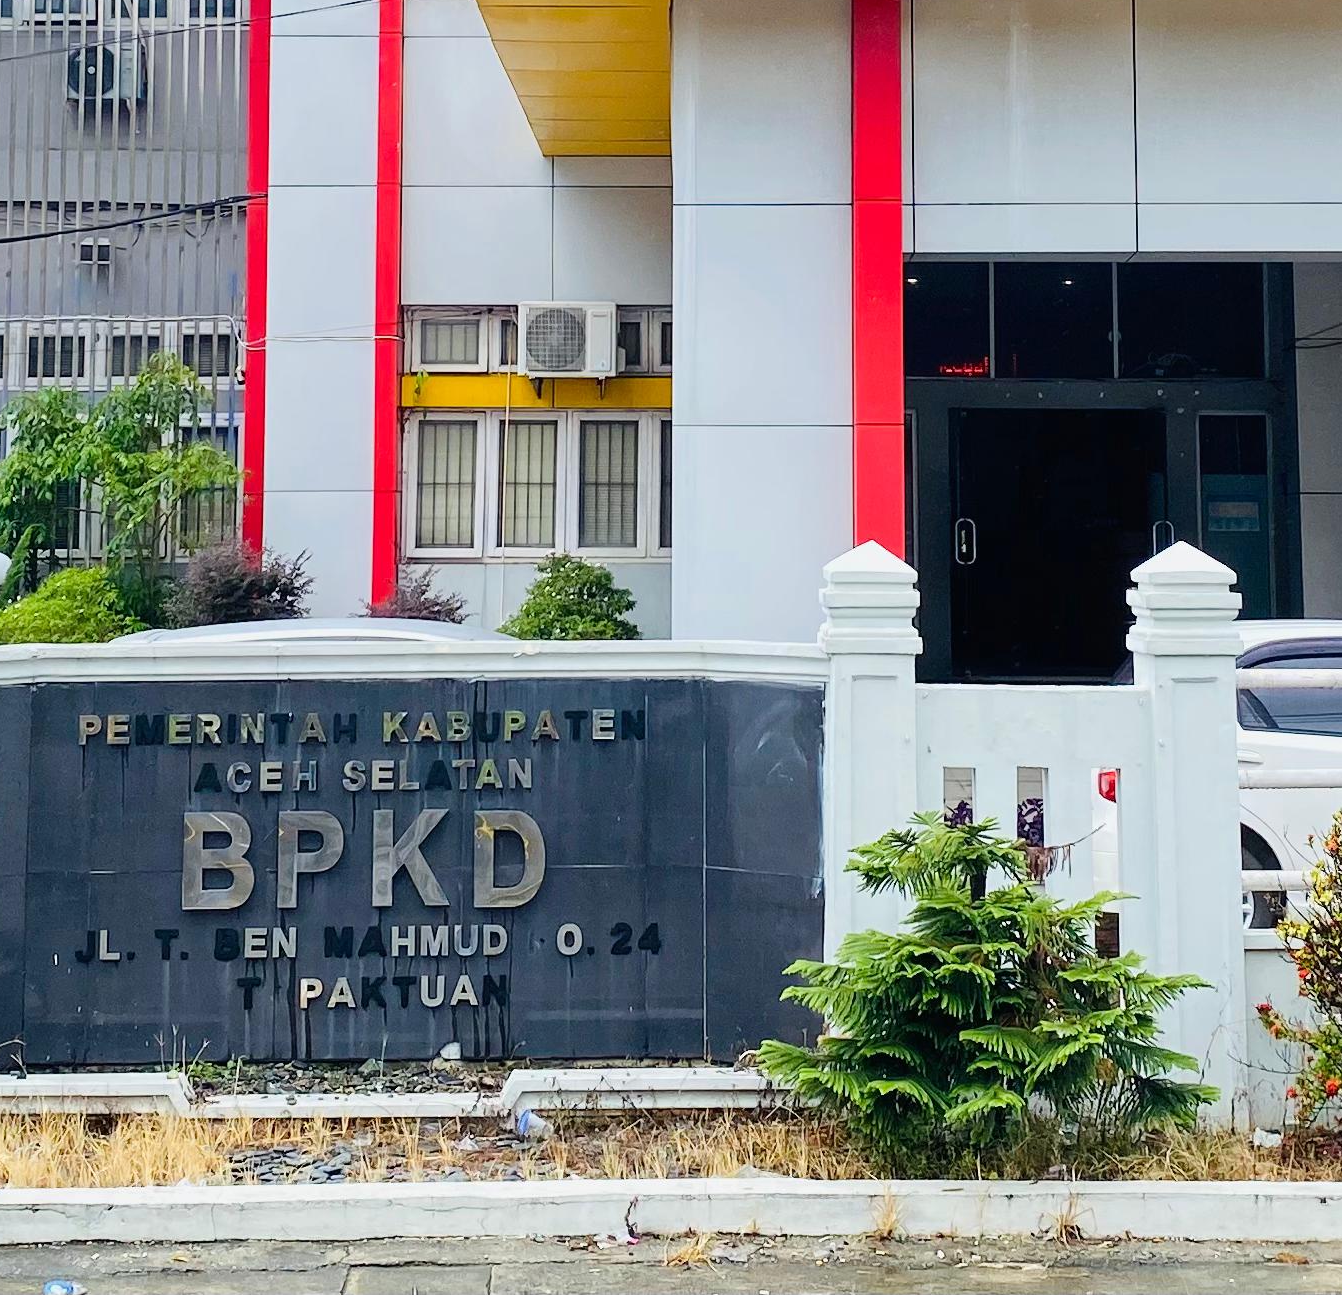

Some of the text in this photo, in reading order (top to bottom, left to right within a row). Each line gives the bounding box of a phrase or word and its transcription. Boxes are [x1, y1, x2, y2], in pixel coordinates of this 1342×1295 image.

[77, 708, 647, 747] PEMERINTAH KABUPATEN
[193, 757, 533, 795] ACEH SELATAN
[181, 808, 546, 911] BPKD
[74, 928, 136, 964] JL.
[154, 928, 190, 962] T.
[213, 925, 298, 960] BEN
[323, 923, 509, 959] MAHMUD
[609, 922, 662, 956] 24
[237, 973, 510, 1010] TPAKTUAN
